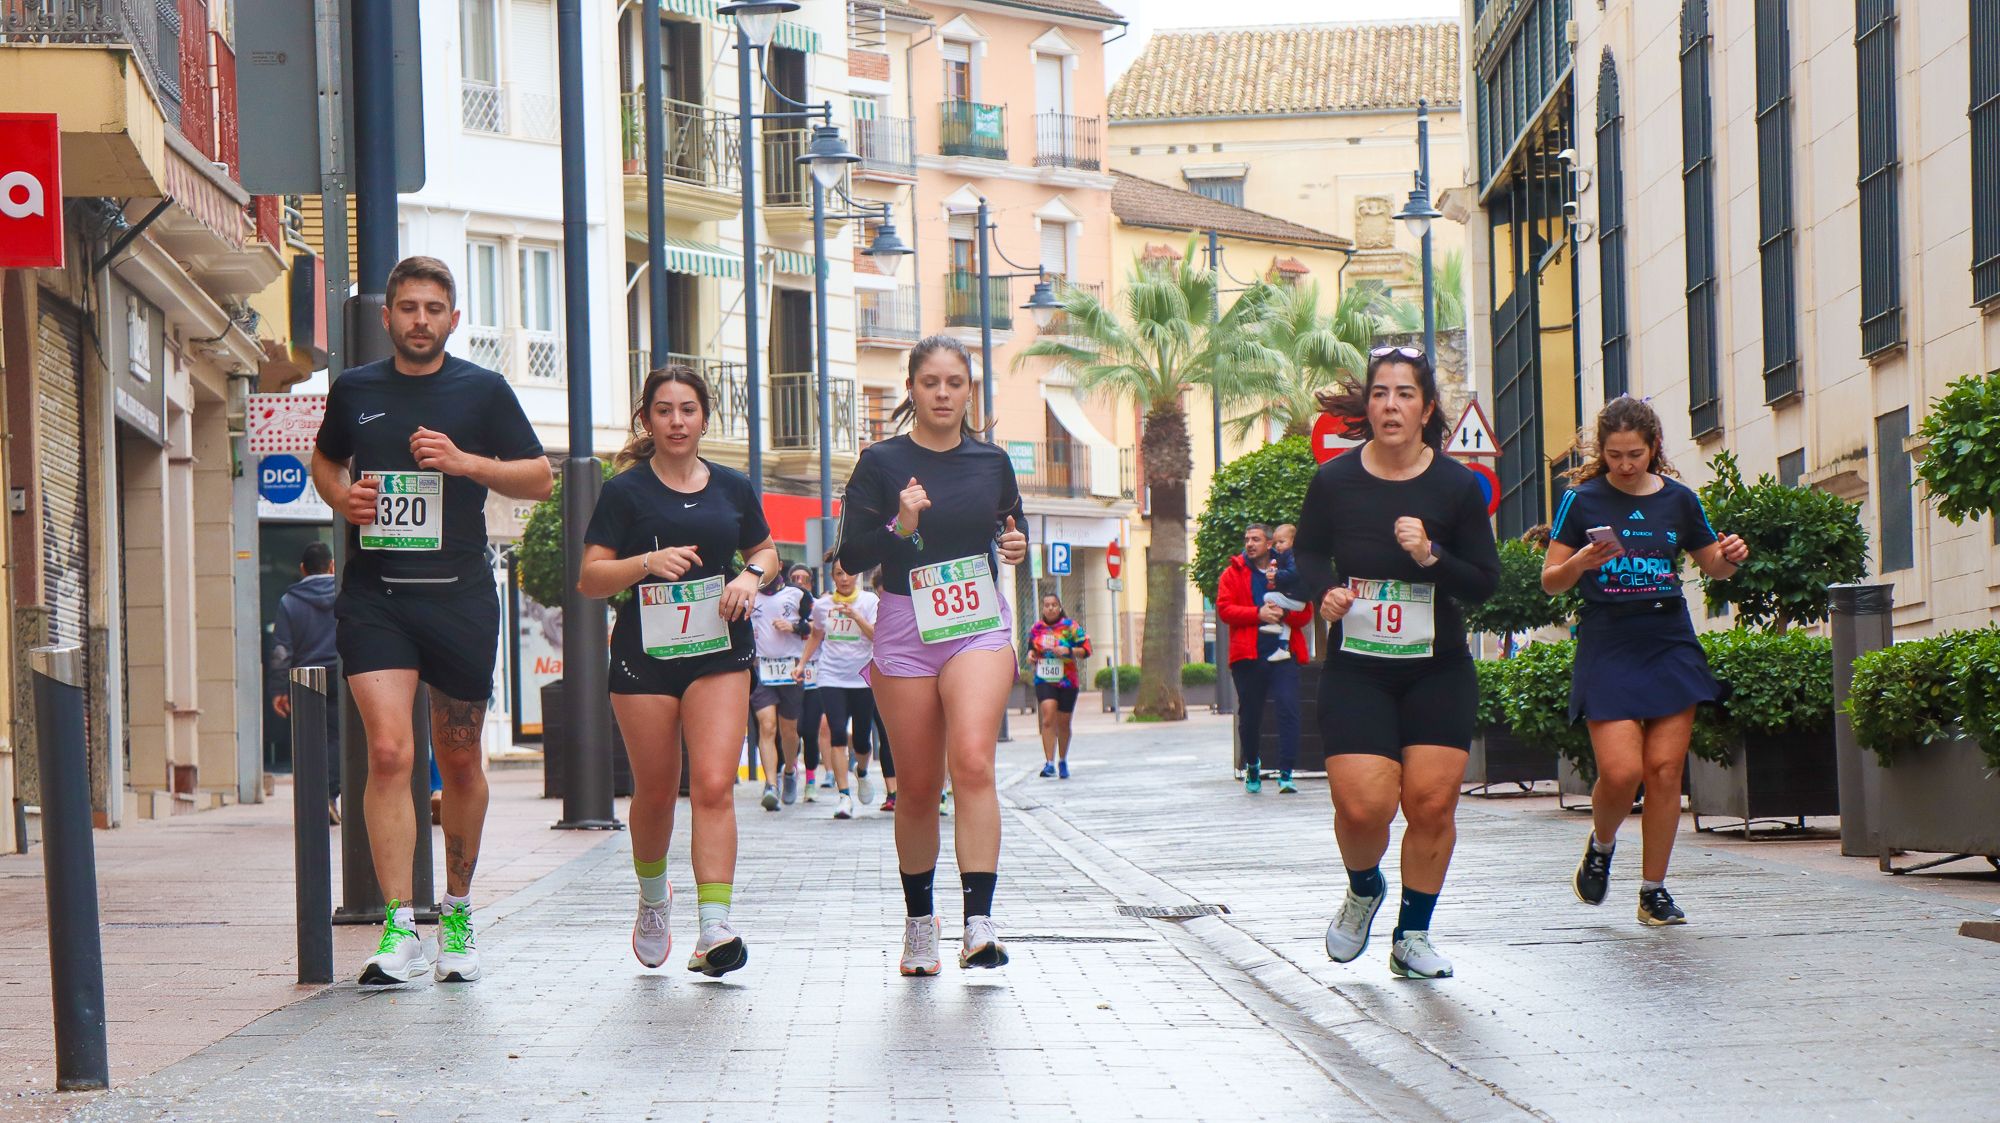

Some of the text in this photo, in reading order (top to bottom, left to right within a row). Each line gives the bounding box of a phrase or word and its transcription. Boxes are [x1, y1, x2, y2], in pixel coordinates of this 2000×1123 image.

[263, 469, 301, 483] DIGI
[1053, 545, 1068, 571] P
[917, 567, 945, 588] 10K
[648, 585, 676, 605] 10K
[931, 581, 980, 617] 835
[677, 605, 691, 634] 7
[833, 619, 852, 632] 717
[1372, 603, 1402, 633] 19
[768, 663, 787, 676] 112
[1042, 666, 1060, 676] 1540
